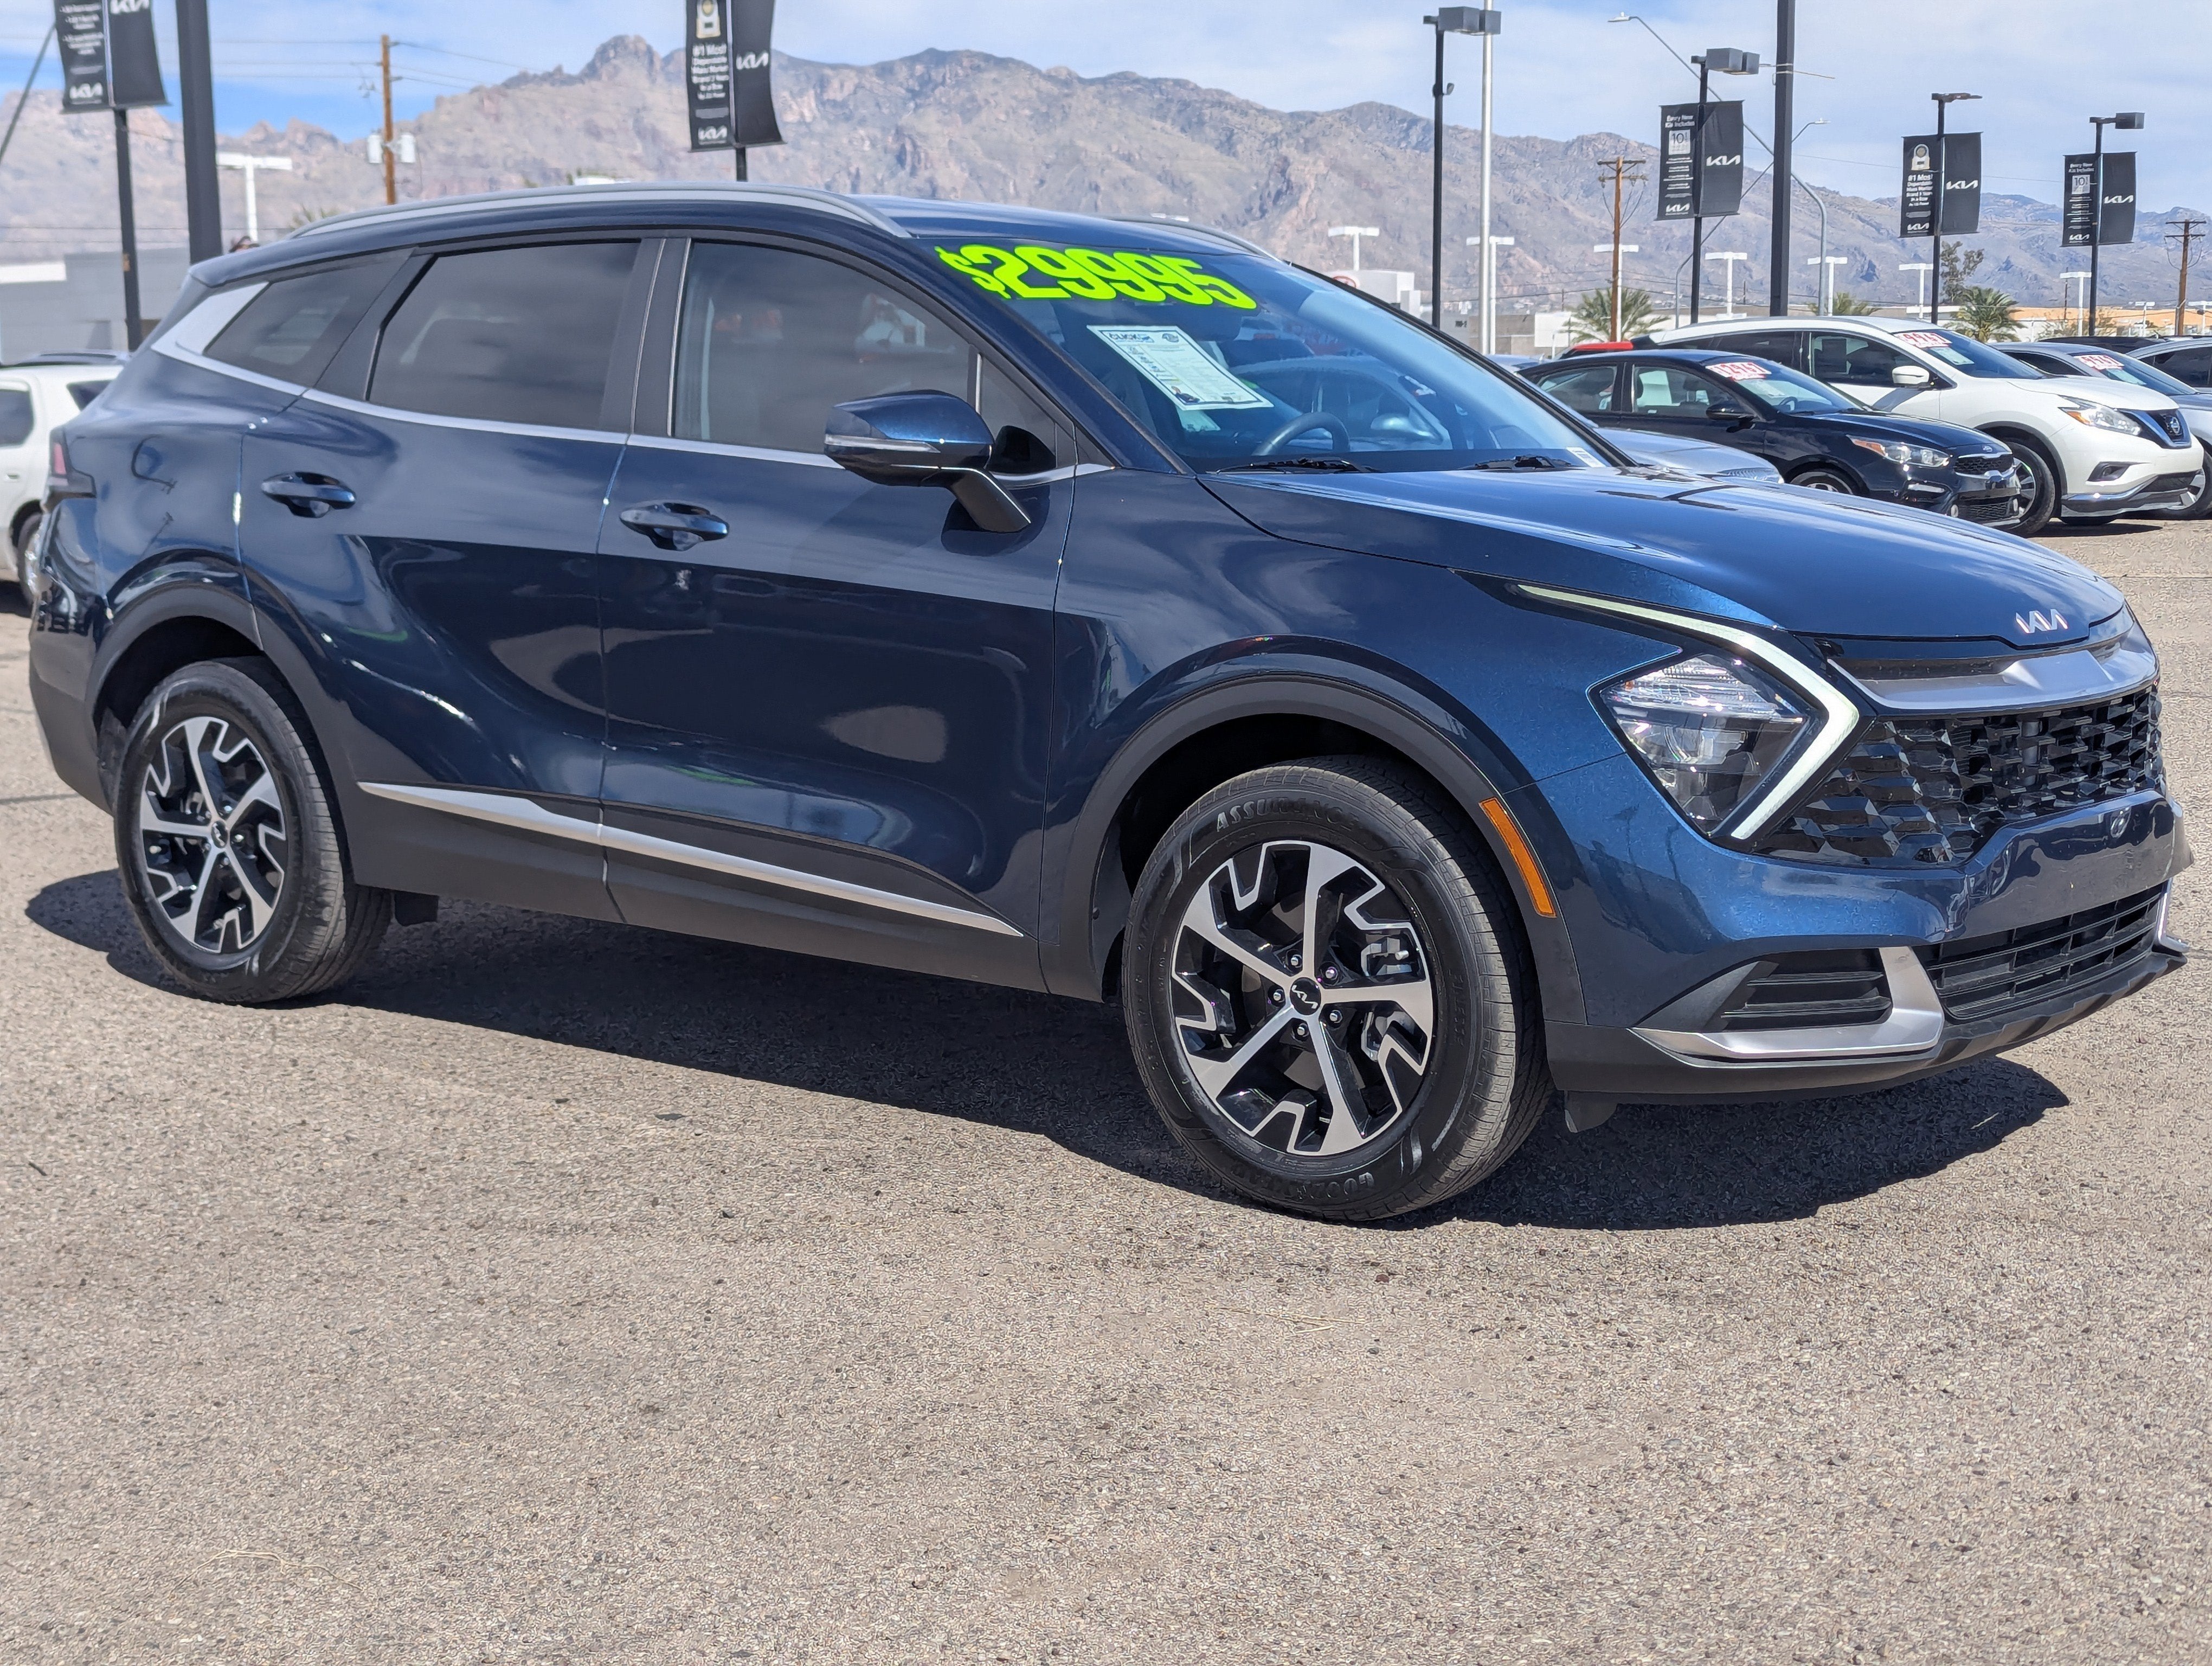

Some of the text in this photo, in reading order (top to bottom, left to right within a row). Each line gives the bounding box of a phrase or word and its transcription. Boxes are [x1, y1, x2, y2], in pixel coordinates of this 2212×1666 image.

[736, 52, 769, 70] KIA
[698, 126, 727, 139] KIA
[1706, 155, 1740, 166] KIA
[1946, 180, 1978, 189] KIA
[2104, 195, 2134, 203] KIA
[1666, 203, 1690, 212] KIA
[1907, 222, 1930, 230] KIA
[934, 244, 1257, 309] $29995
[2015, 608, 2068, 633] KIA
